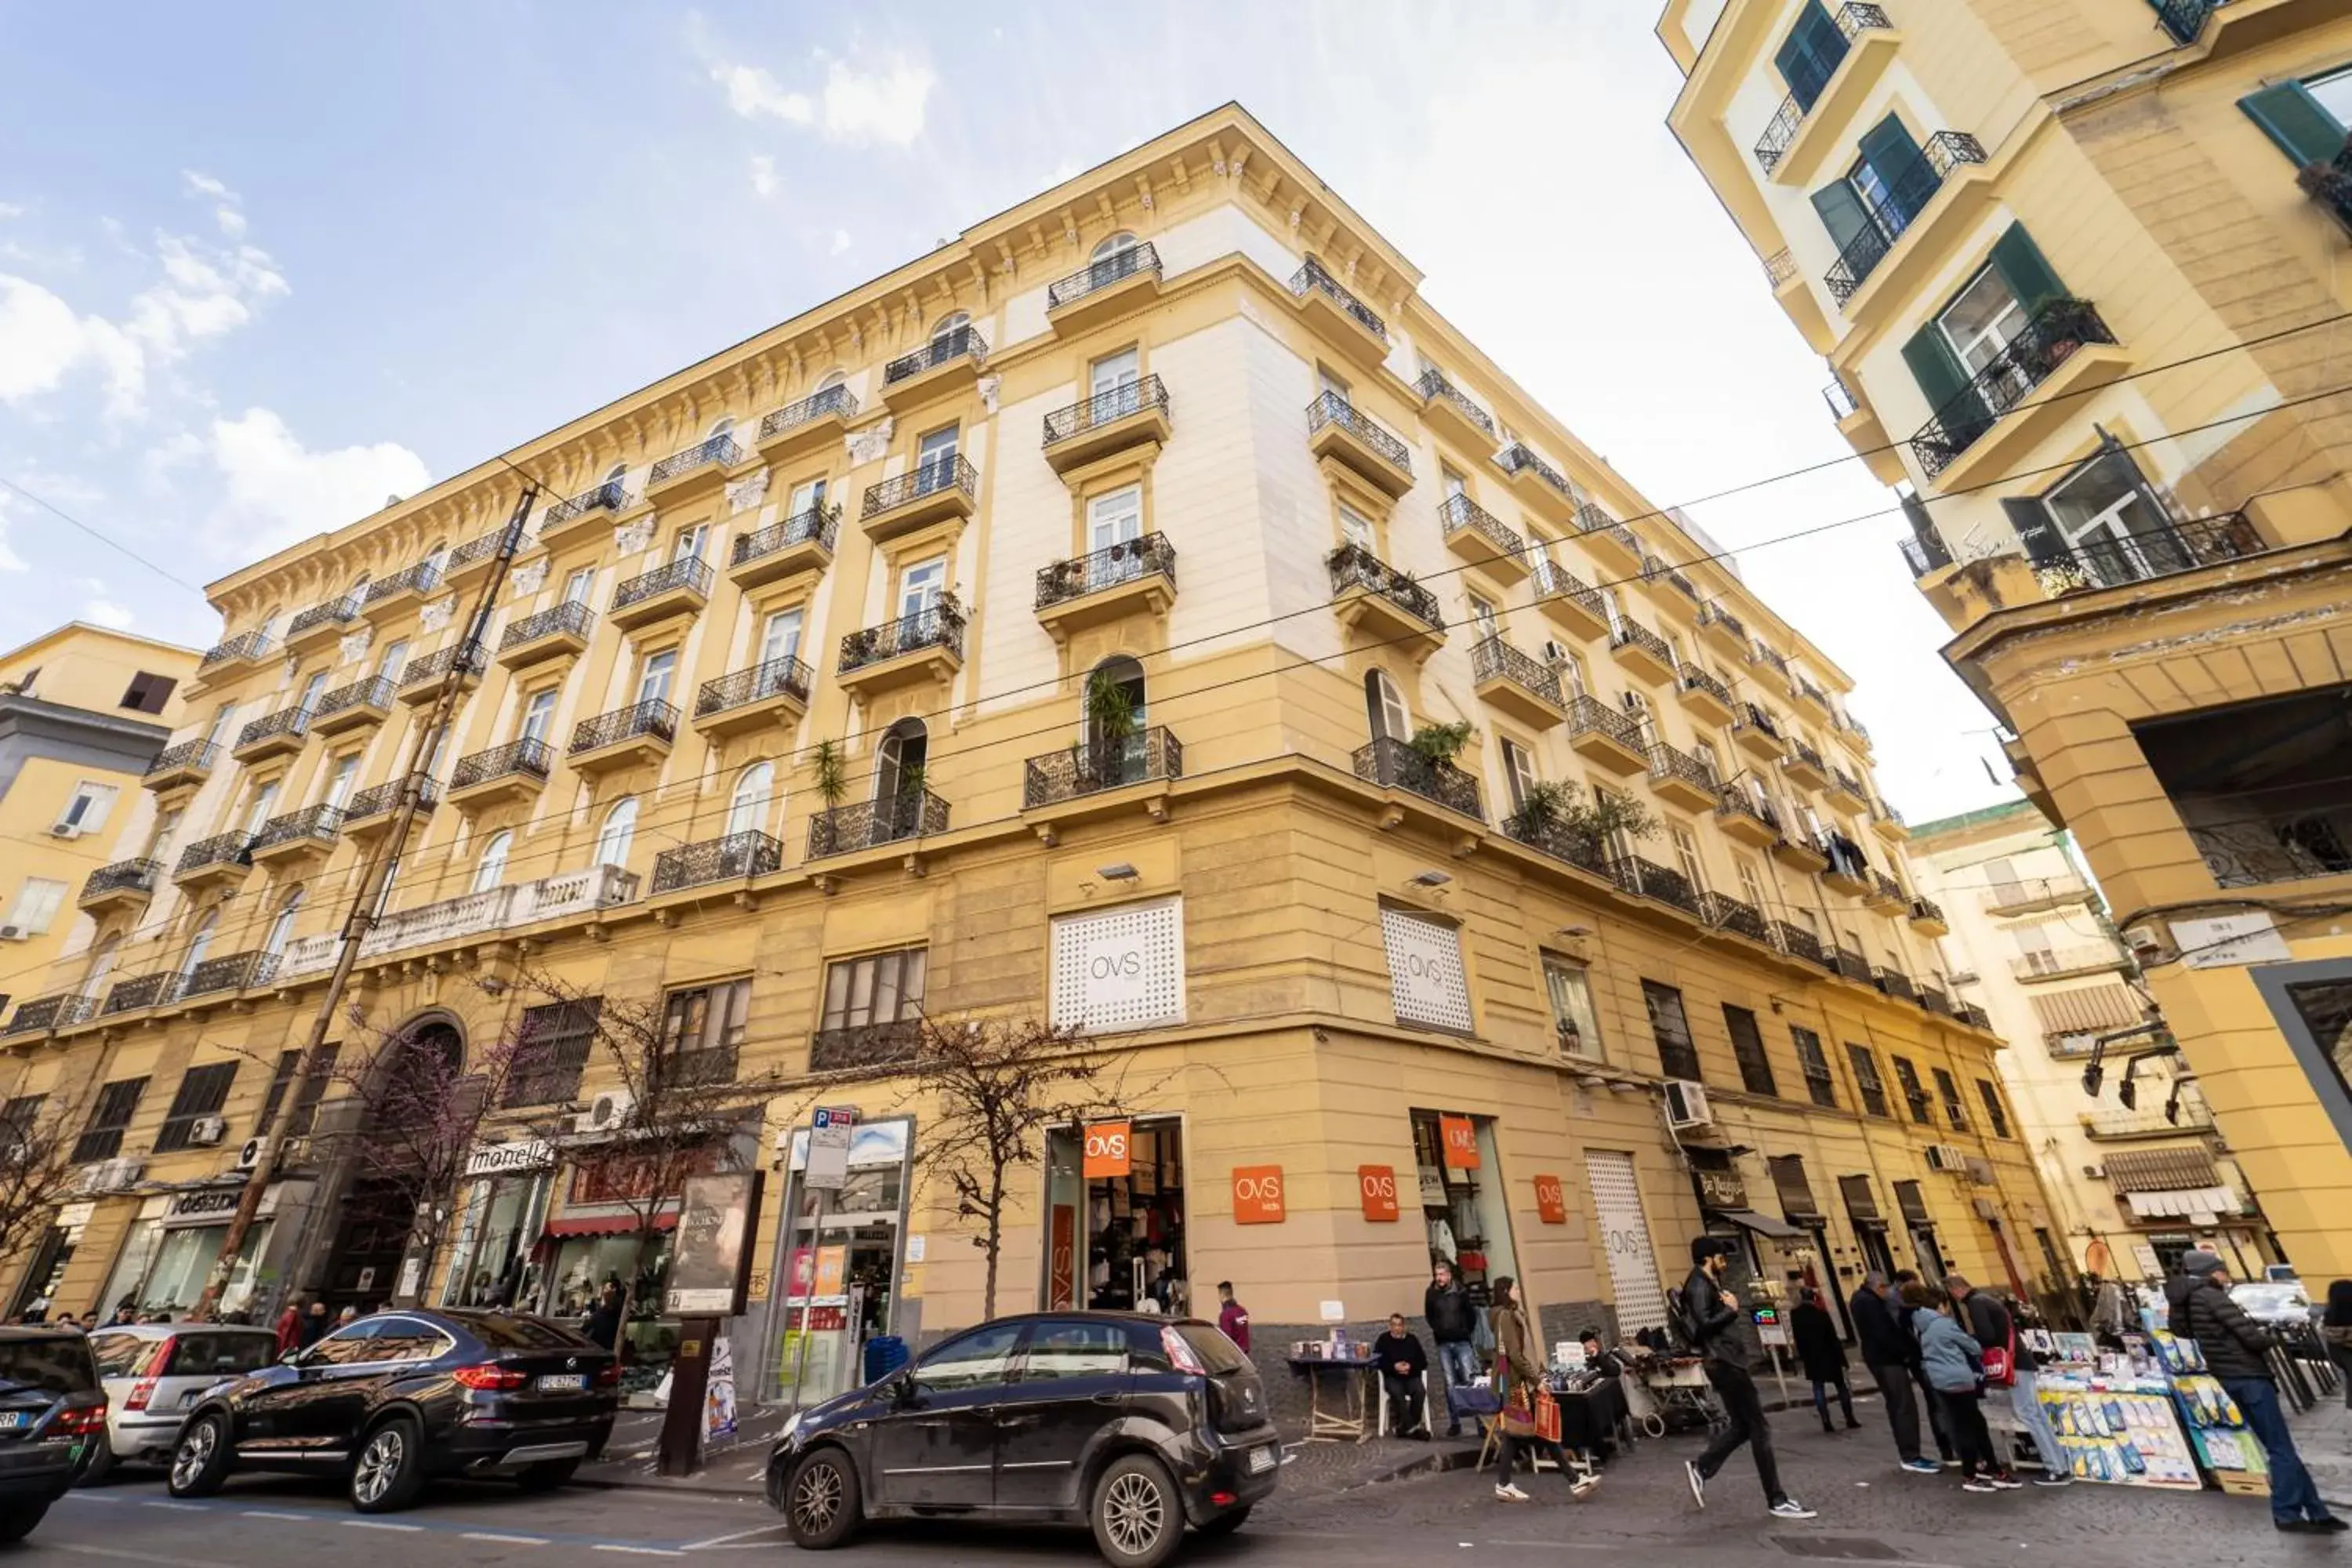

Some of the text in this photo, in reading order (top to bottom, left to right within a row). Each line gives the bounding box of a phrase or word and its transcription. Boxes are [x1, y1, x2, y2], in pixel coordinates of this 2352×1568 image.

[1091, 951, 1141, 979] OVS
[1409, 953, 1443, 982] OVS
[1087, 1134, 1126, 1157] OVS
[1236, 1177, 1279, 1200] OVS
[1363, 1175, 1394, 1198] OVS
[1539, 1184, 1561, 1204] OVS
[1611, 1229, 1639, 1254] OVS
